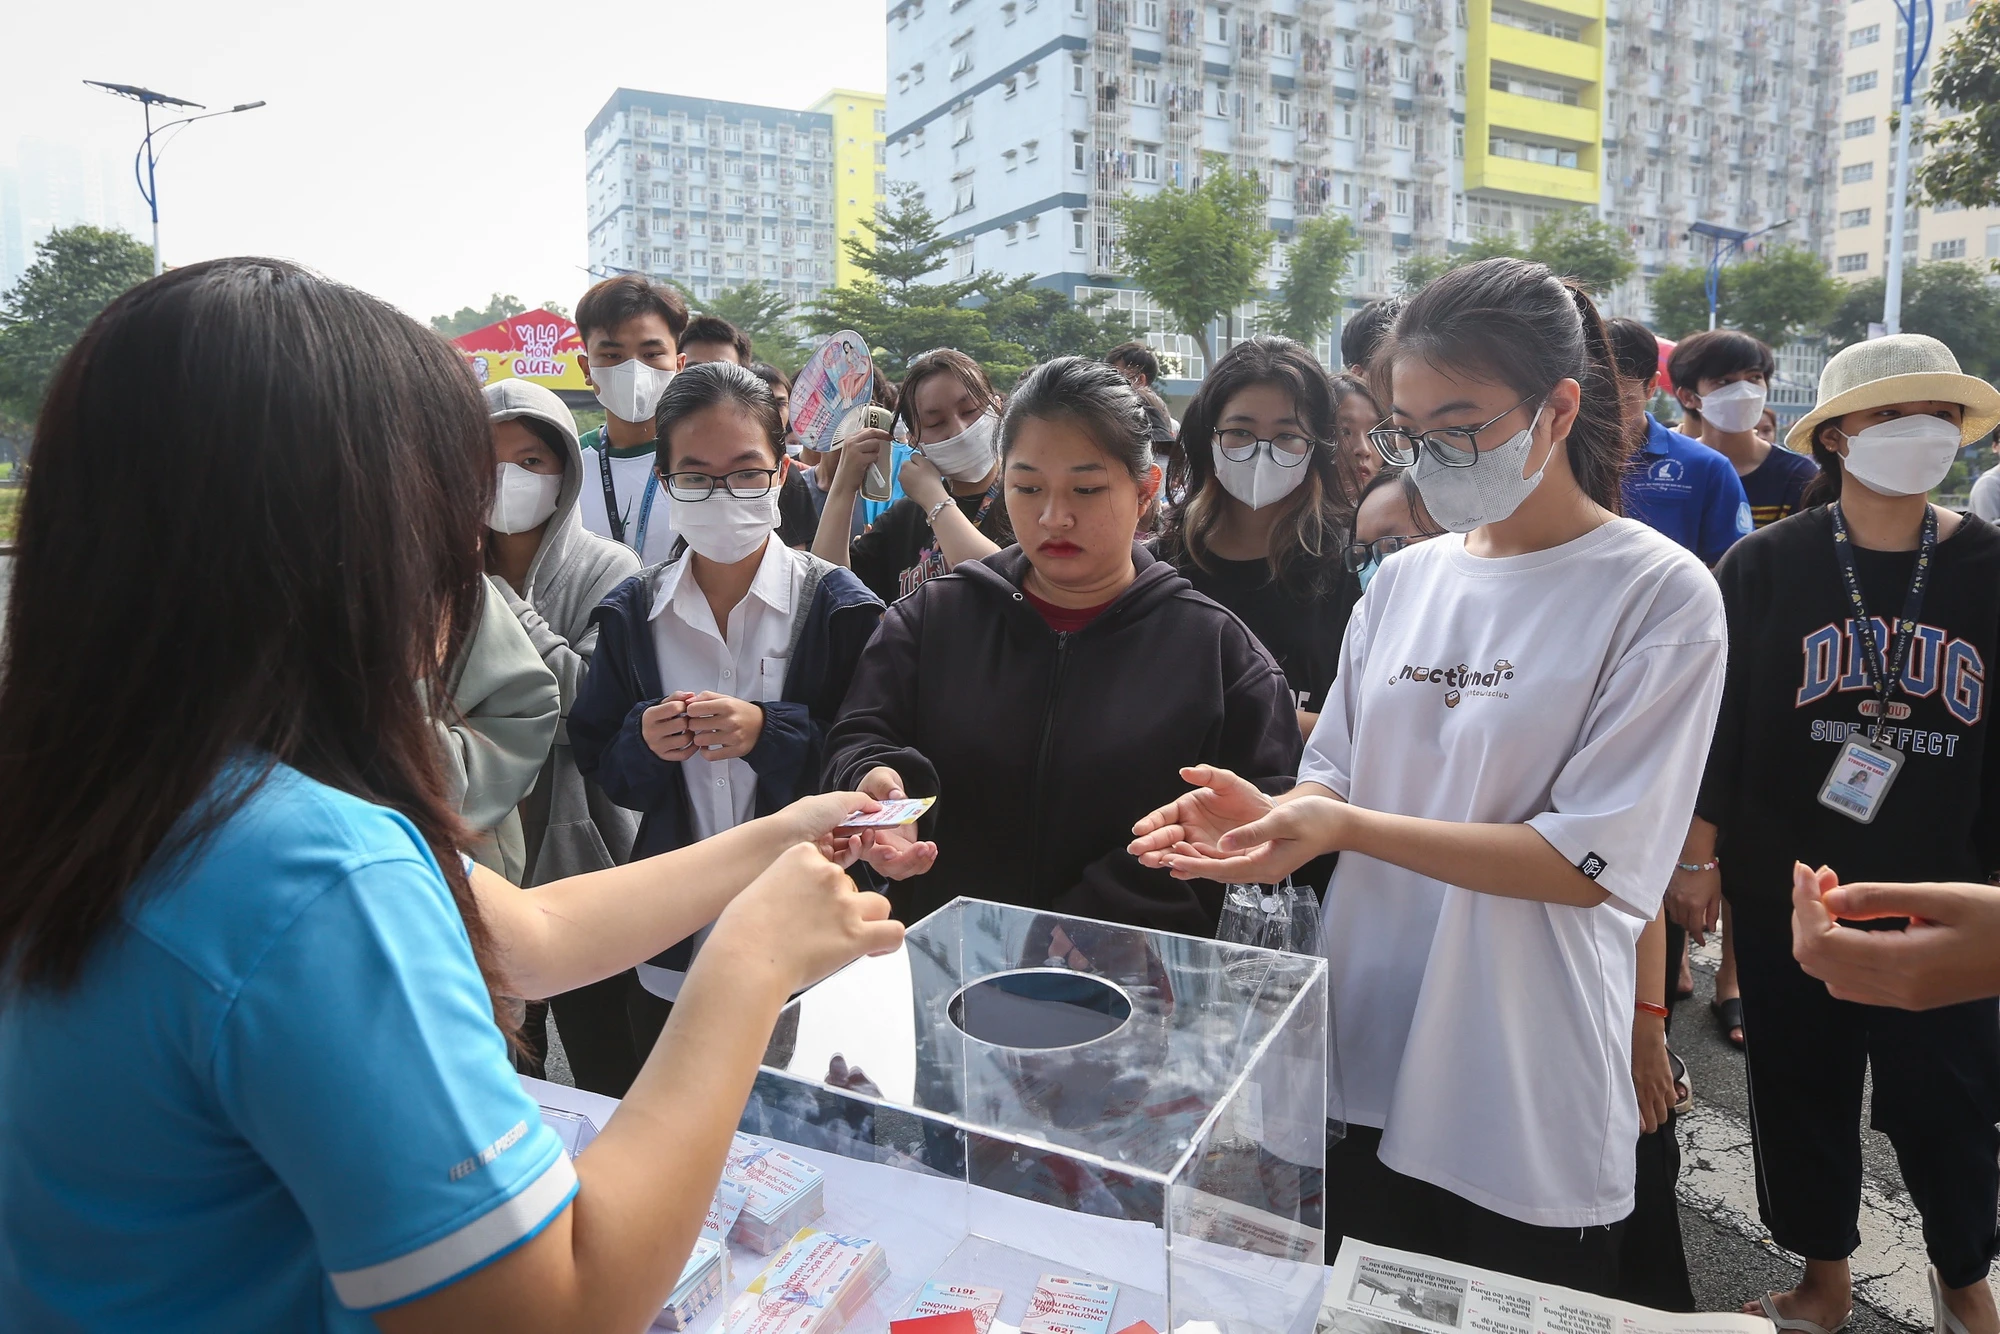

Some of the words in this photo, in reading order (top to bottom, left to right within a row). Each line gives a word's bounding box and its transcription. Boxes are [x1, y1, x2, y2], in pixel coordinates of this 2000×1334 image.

[517, 325, 533, 346] VỊ
[538, 325, 556, 345] LẠ
[525, 343, 551, 358] MÓN
[515, 359, 564, 375] QUEN
[1795, 616, 1985, 726] DRUG
[1861, 703, 1909, 717] WITOUT
[449, 1157, 477, 1183] FEEL
[949, 1286, 975, 1295] 4613
[1047, 1326, 1074, 1334] 4621
